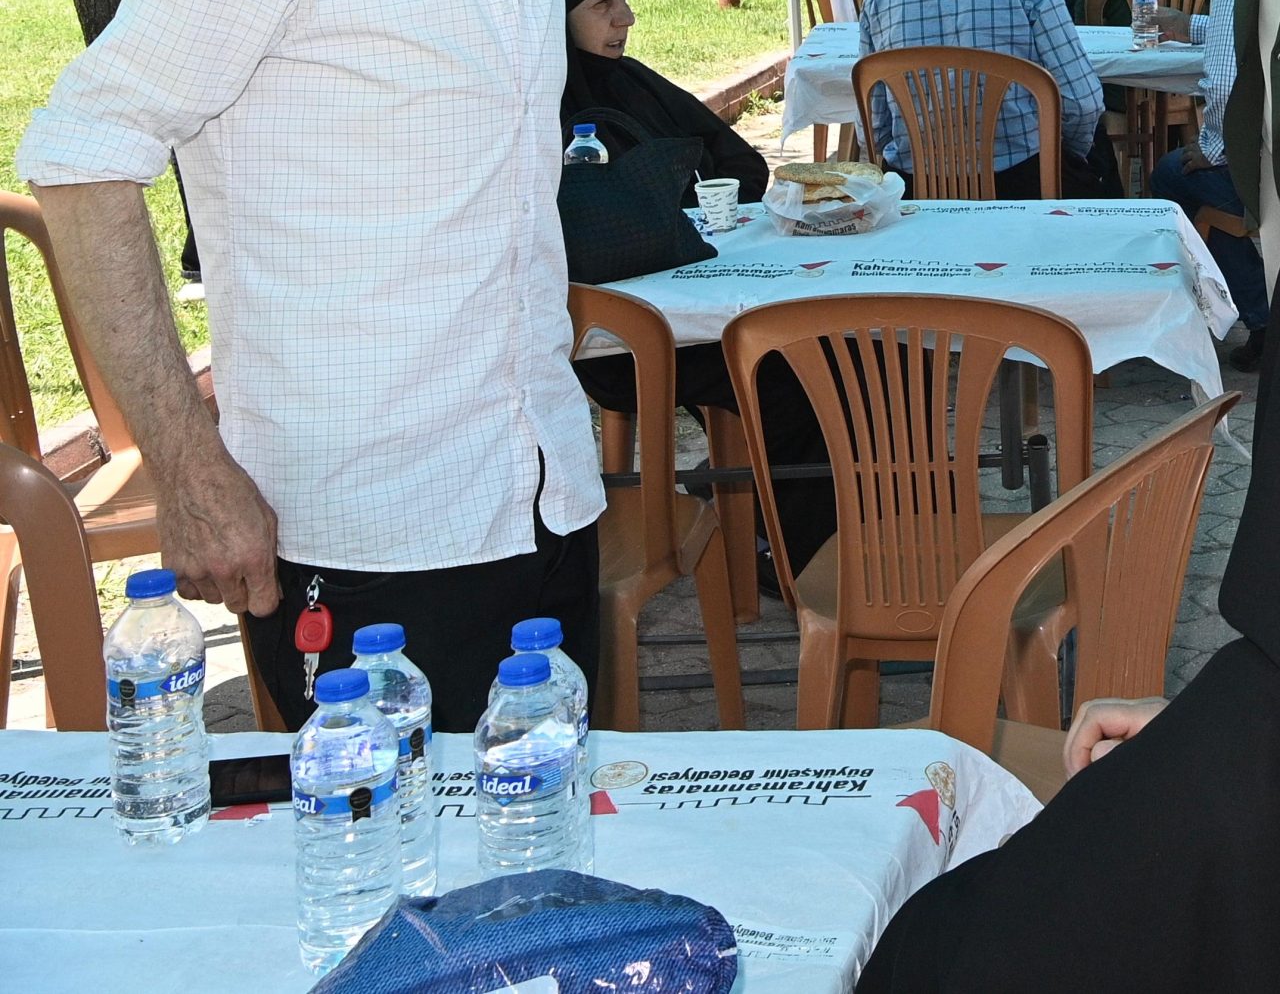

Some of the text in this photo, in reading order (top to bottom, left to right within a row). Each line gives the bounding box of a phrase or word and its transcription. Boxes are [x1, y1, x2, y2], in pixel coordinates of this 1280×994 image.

[649, 766, 875, 782] Büyükşehir Belediyesi
[481, 773, 533, 794] ideal
[642, 779, 867, 795] Kahramanmaraş
[293, 795, 317, 815] eal
